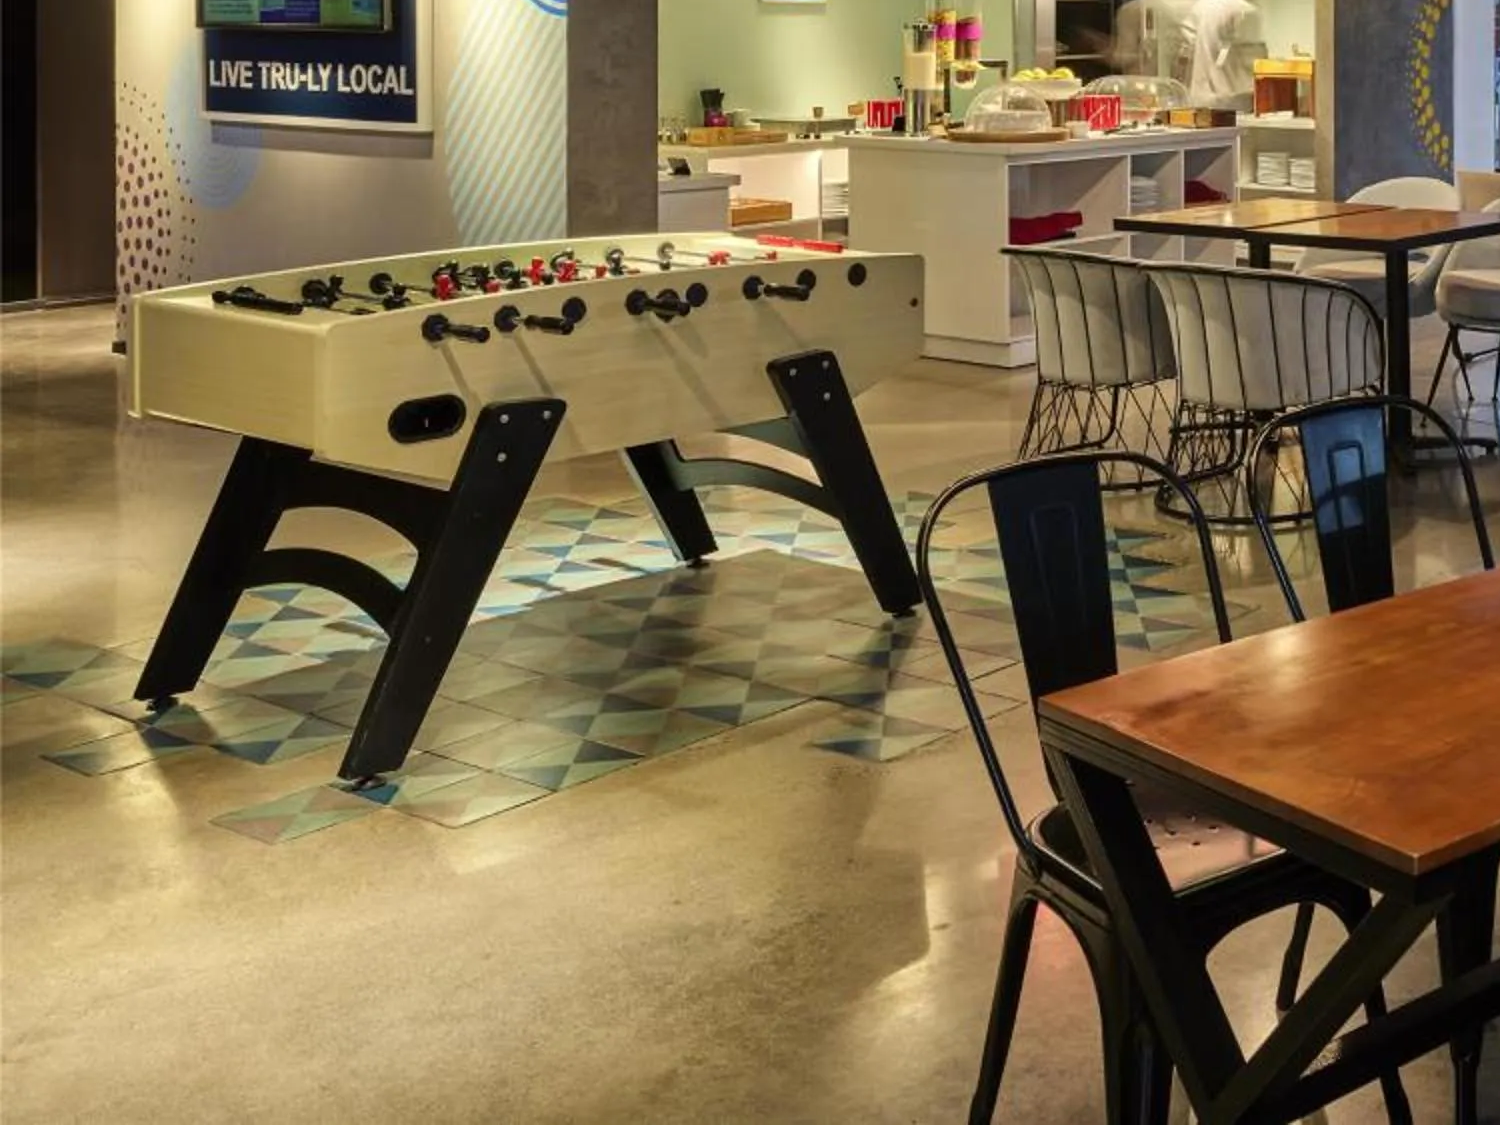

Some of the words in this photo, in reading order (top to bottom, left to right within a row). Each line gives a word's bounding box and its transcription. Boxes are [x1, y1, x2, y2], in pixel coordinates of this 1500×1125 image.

[209, 59, 253, 88] LIVE
[257, 62, 332, 92] TRU-LY
[337, 63, 414, 96] LOCAL
